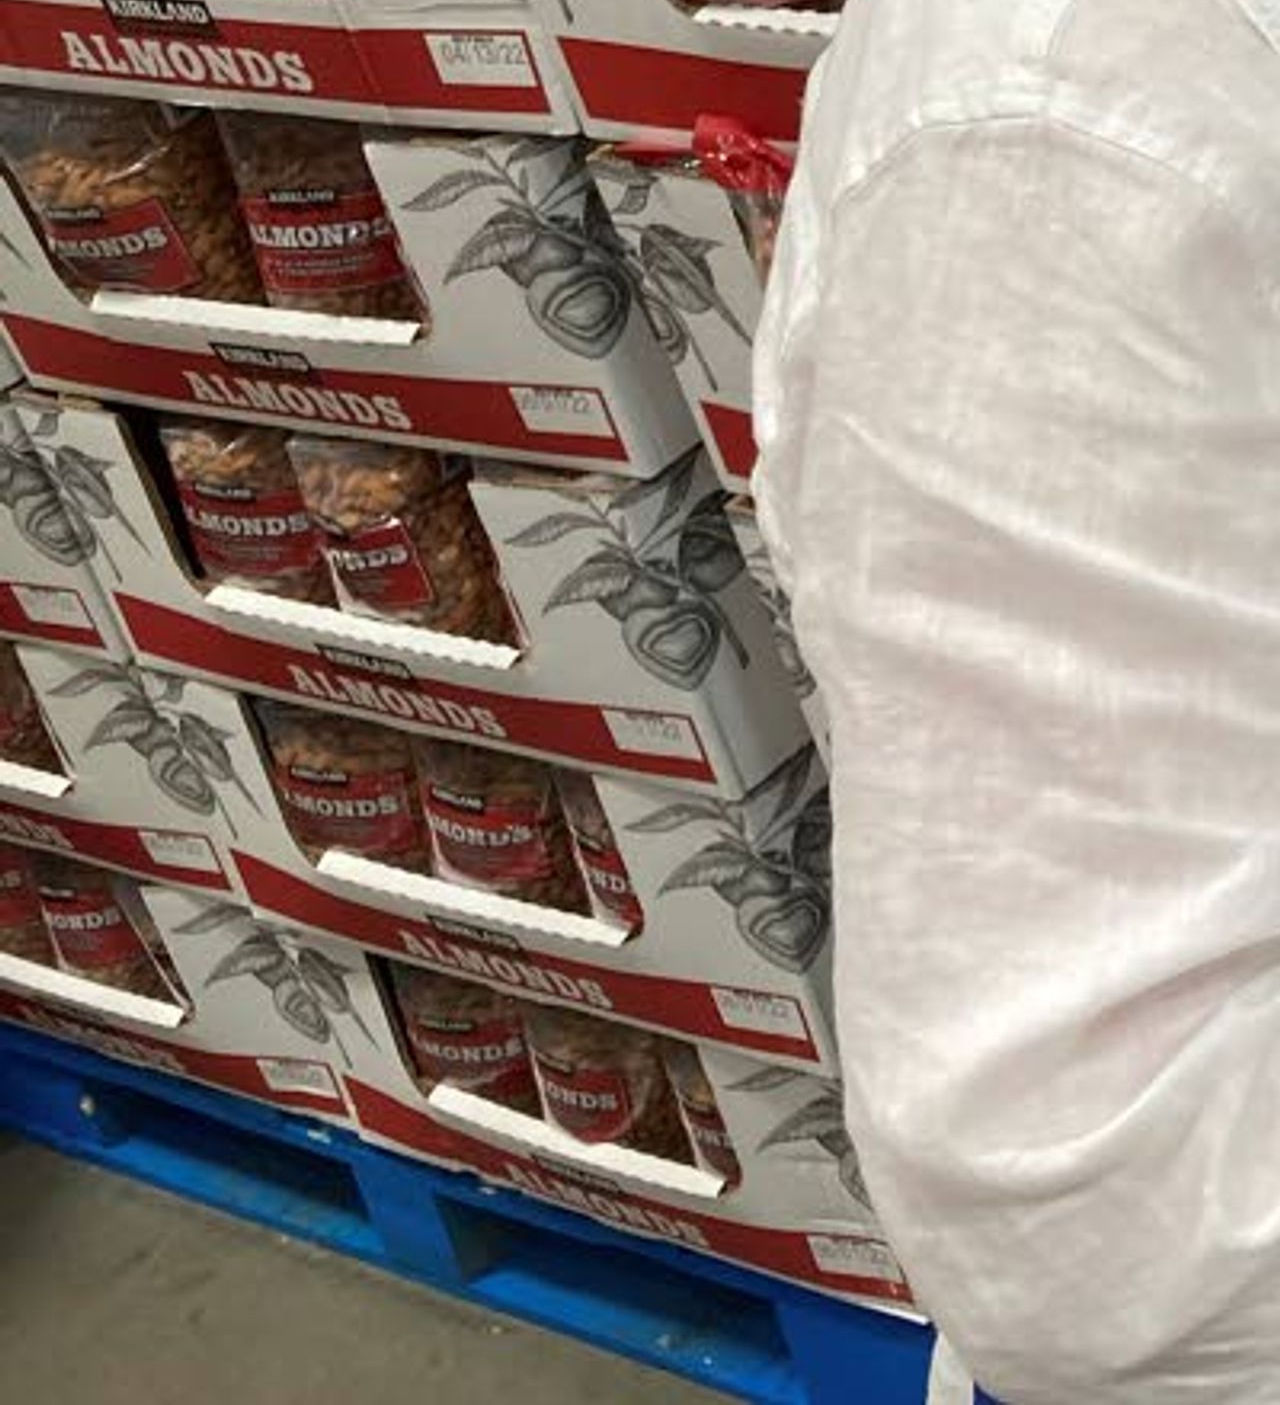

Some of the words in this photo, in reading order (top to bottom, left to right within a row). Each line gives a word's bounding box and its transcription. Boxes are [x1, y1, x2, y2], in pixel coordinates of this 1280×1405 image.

[61, 31, 314, 92] ALMONDS
[182, 370, 413, 431] ALMONDS
[288, 664, 508, 740] ALMONDS
[400, 930, 614, 1010] ALMONDS
